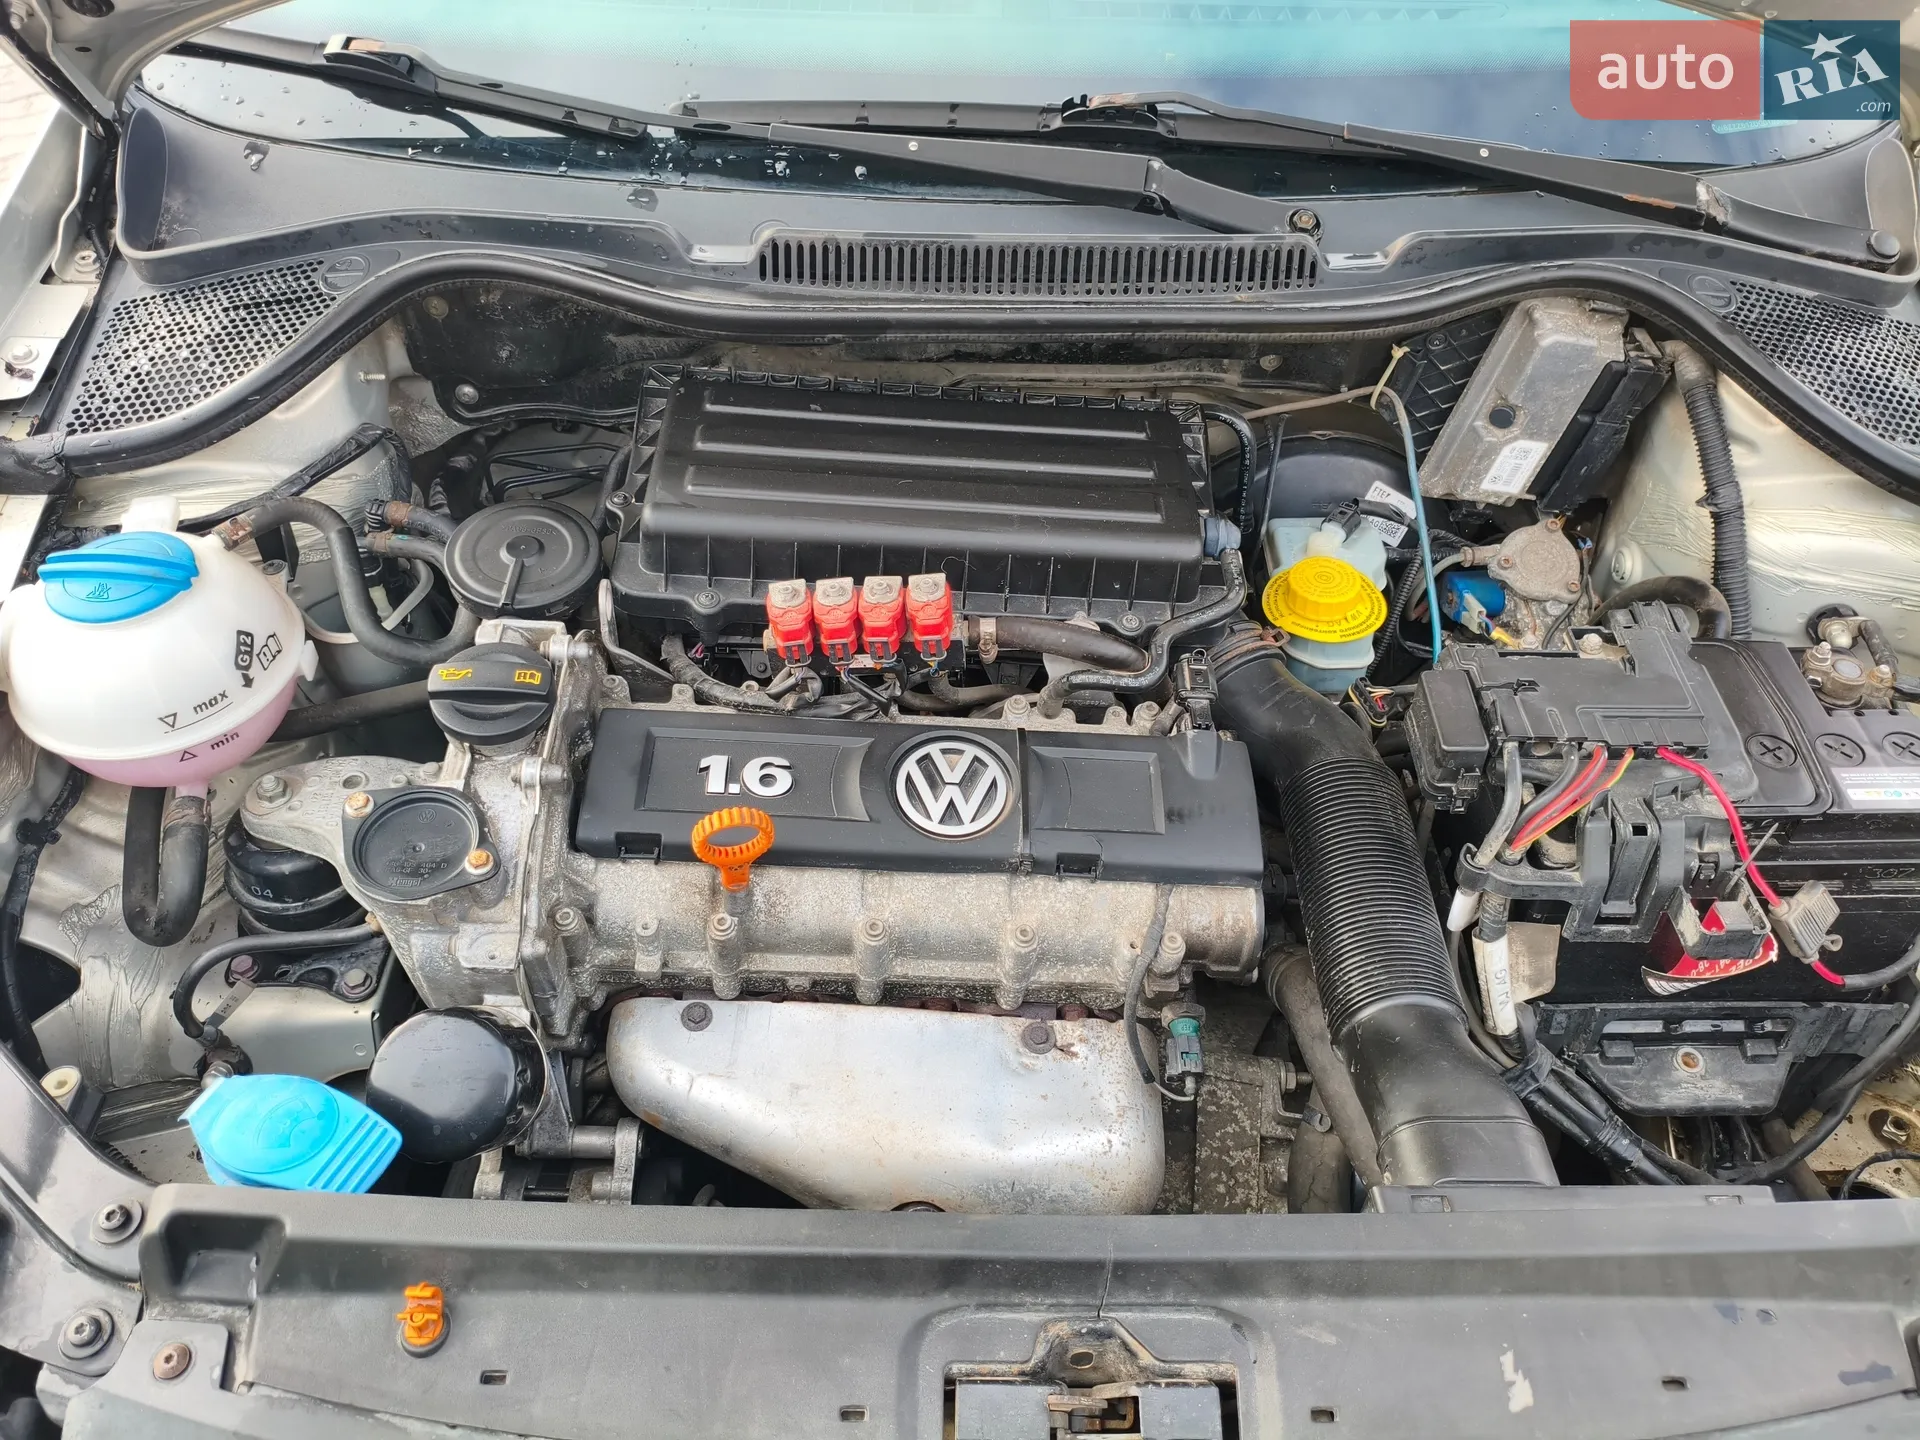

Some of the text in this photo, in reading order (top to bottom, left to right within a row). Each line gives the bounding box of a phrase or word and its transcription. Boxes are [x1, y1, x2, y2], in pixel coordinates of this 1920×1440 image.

[237, 634, 253, 666] G12
[192, 689, 229, 716] max
[210, 730, 240, 751] min
[697, 754, 796, 799] 1.6
[251, 885, 274, 899] 04
